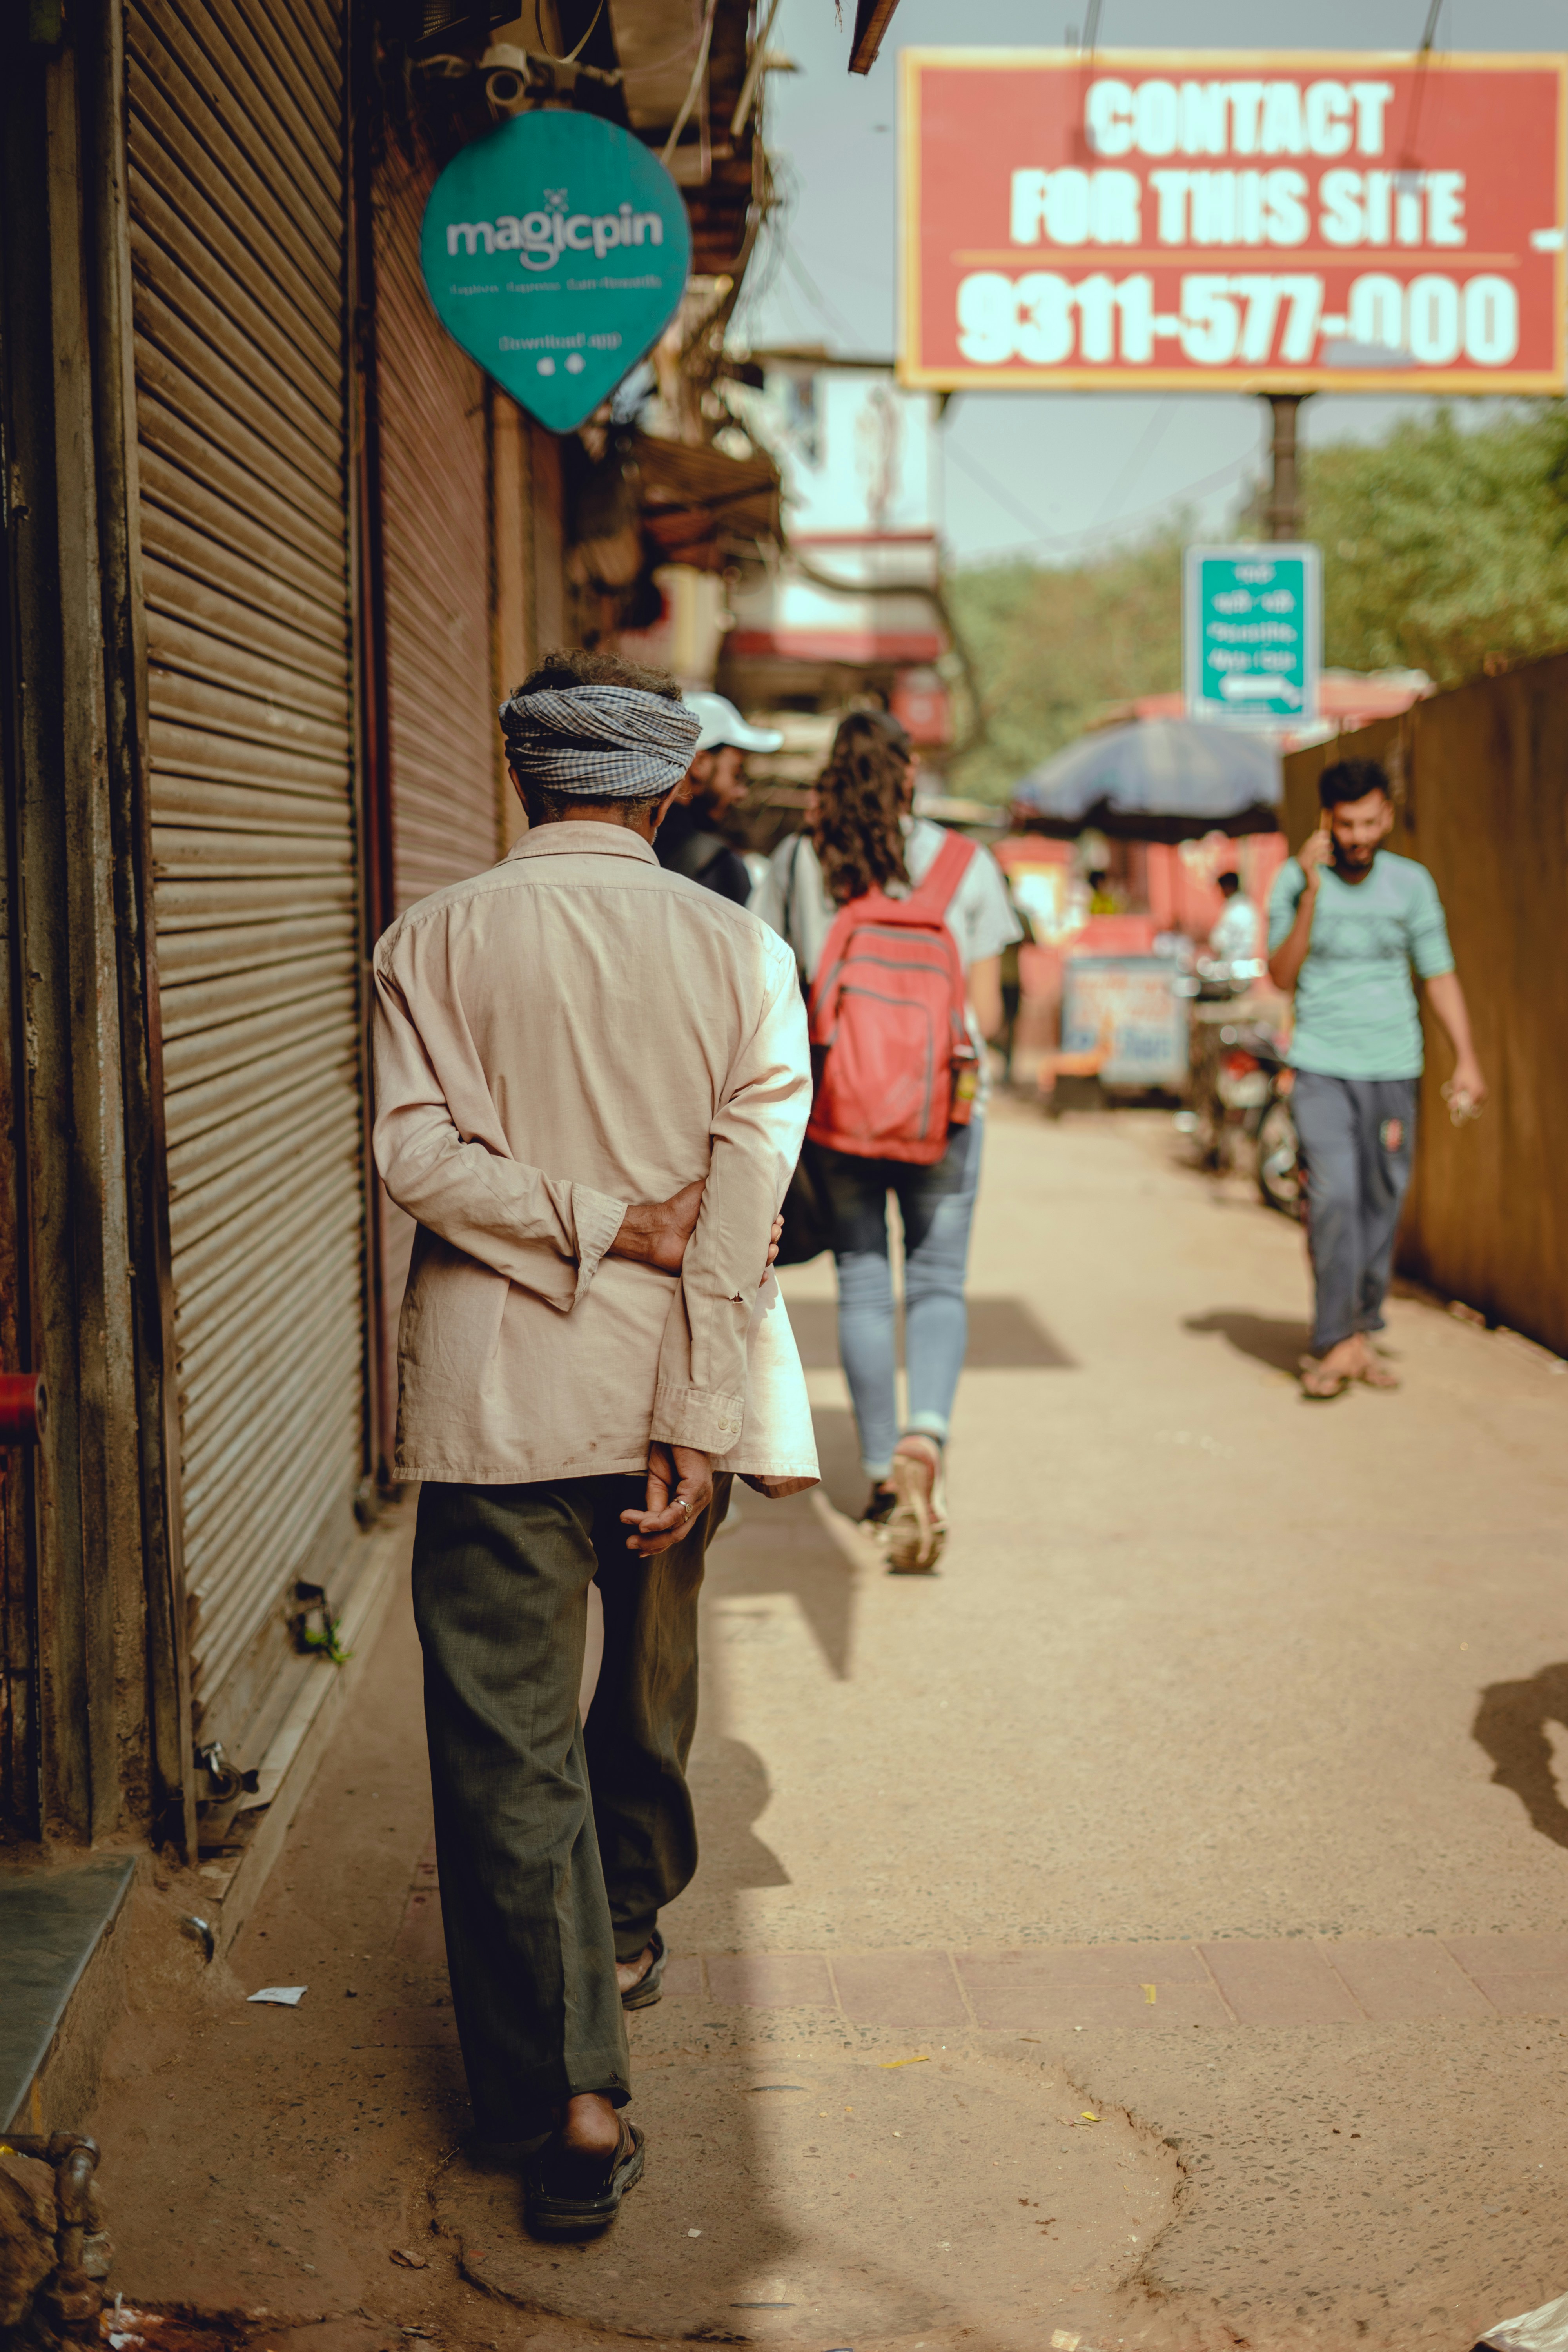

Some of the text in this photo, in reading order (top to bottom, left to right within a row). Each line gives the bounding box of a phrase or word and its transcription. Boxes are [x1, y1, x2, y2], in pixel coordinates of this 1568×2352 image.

[1085, 77, 1395, 158] CONTACT
[446, 201, 663, 271] magicpin
[1009, 167, 1467, 248] FOR THIS SITE
[956, 270, 1519, 365] 9311-577-000
